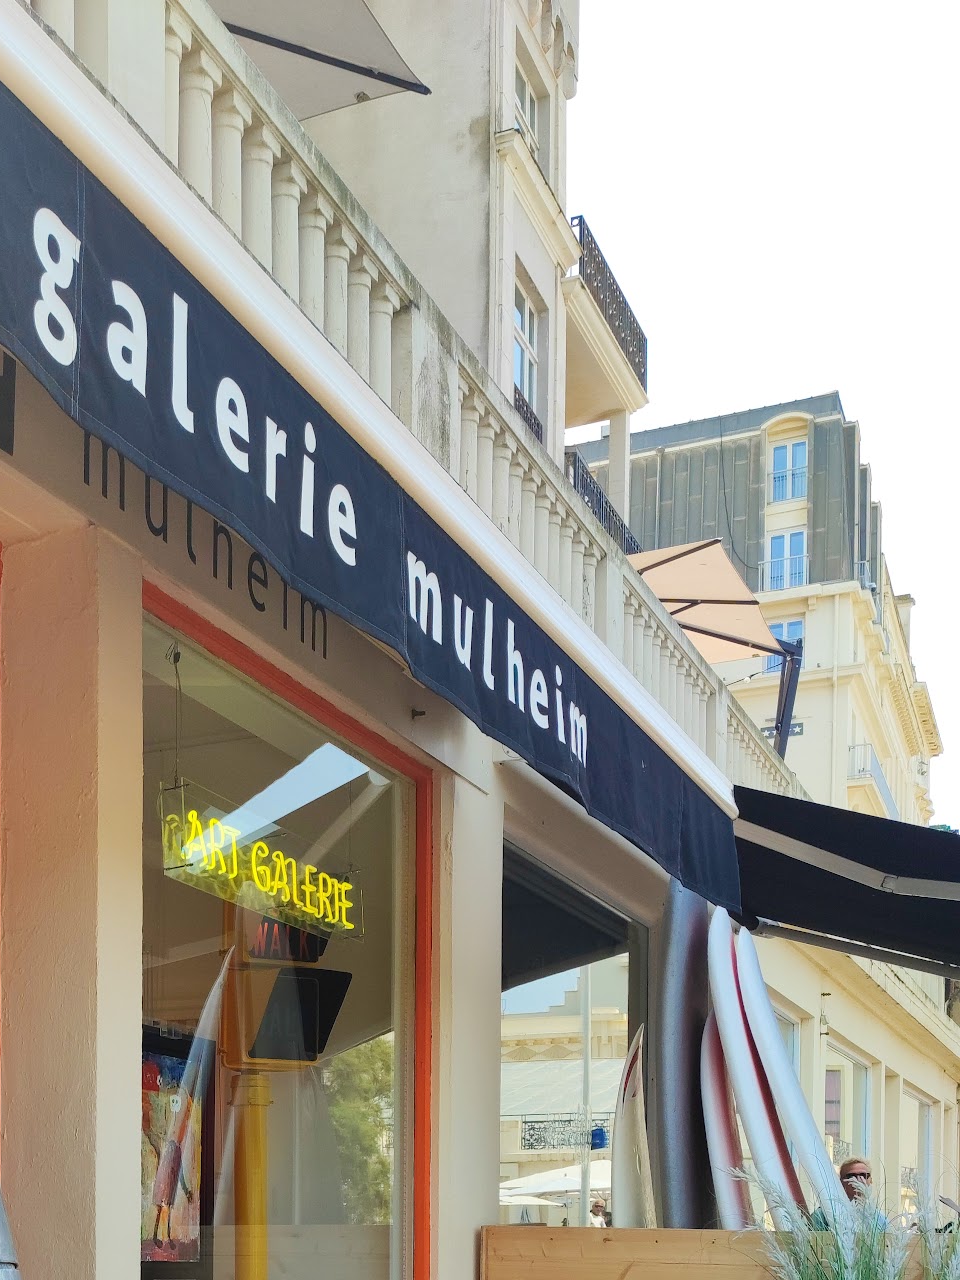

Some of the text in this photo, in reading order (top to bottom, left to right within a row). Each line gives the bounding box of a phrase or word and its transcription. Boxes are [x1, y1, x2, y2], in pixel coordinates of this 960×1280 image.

[33, 207, 588, 768] galerie mulheim
[180, 809, 355, 930] ART GALERIE
